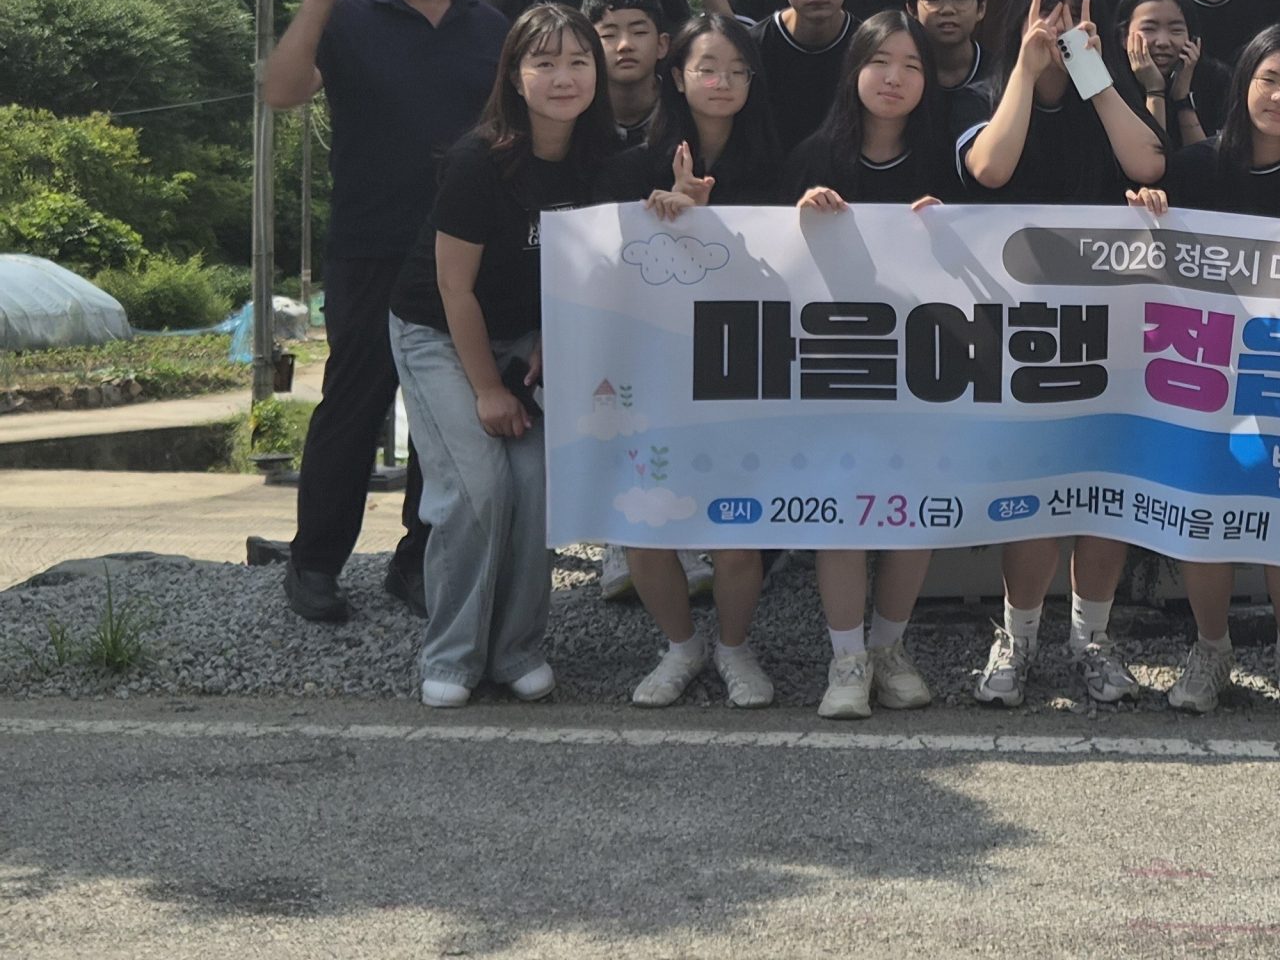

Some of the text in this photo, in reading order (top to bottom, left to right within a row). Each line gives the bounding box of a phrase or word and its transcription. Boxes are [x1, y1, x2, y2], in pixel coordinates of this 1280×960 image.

[1175, 242, 1260, 285] 정읍시
[693, 301, 1109, 403] 마을여행
[719, 501, 751, 520] 일시
[770, 497, 844, 524] 2026.
[998, 500, 1031, 515] 장소
[1047, 486, 1125, 518] 산내면
[1132, 492, 1214, 540] 원덕마을
[1222, 510, 1270, 541] 일대
